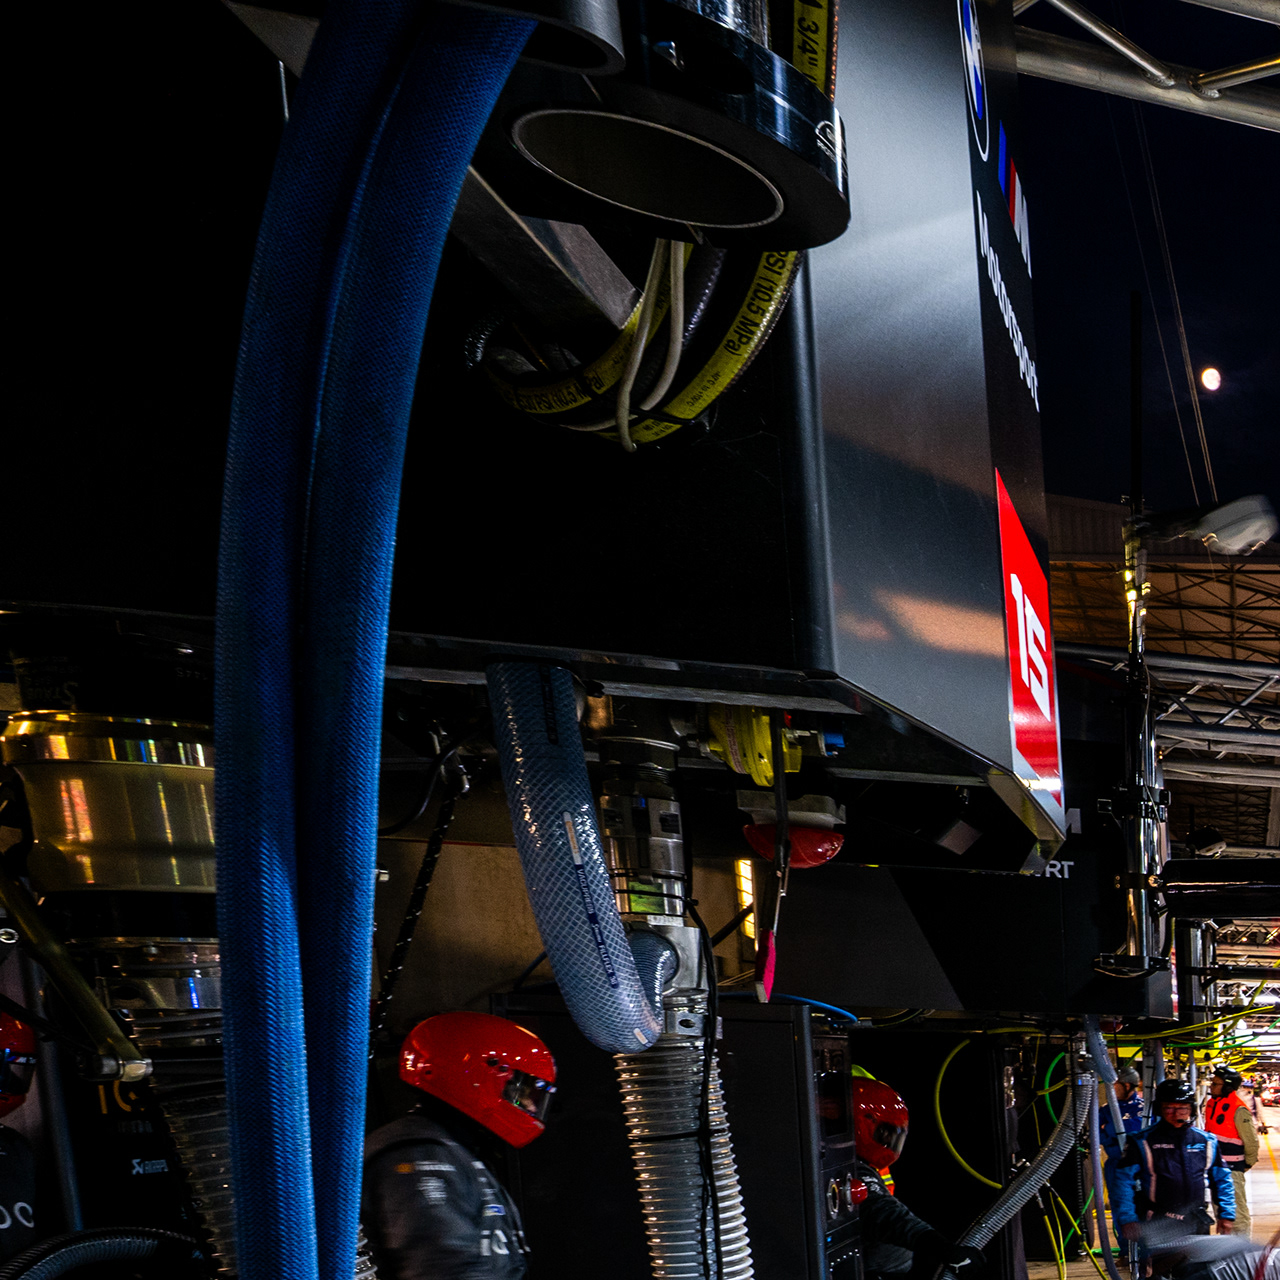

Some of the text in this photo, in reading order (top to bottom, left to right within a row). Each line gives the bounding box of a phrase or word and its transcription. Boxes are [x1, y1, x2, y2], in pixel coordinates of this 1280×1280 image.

[976, 189, 1040, 413] Motorsport
[1010, 572, 1051, 722] 15
[1035, 860, 1075, 879] RT
